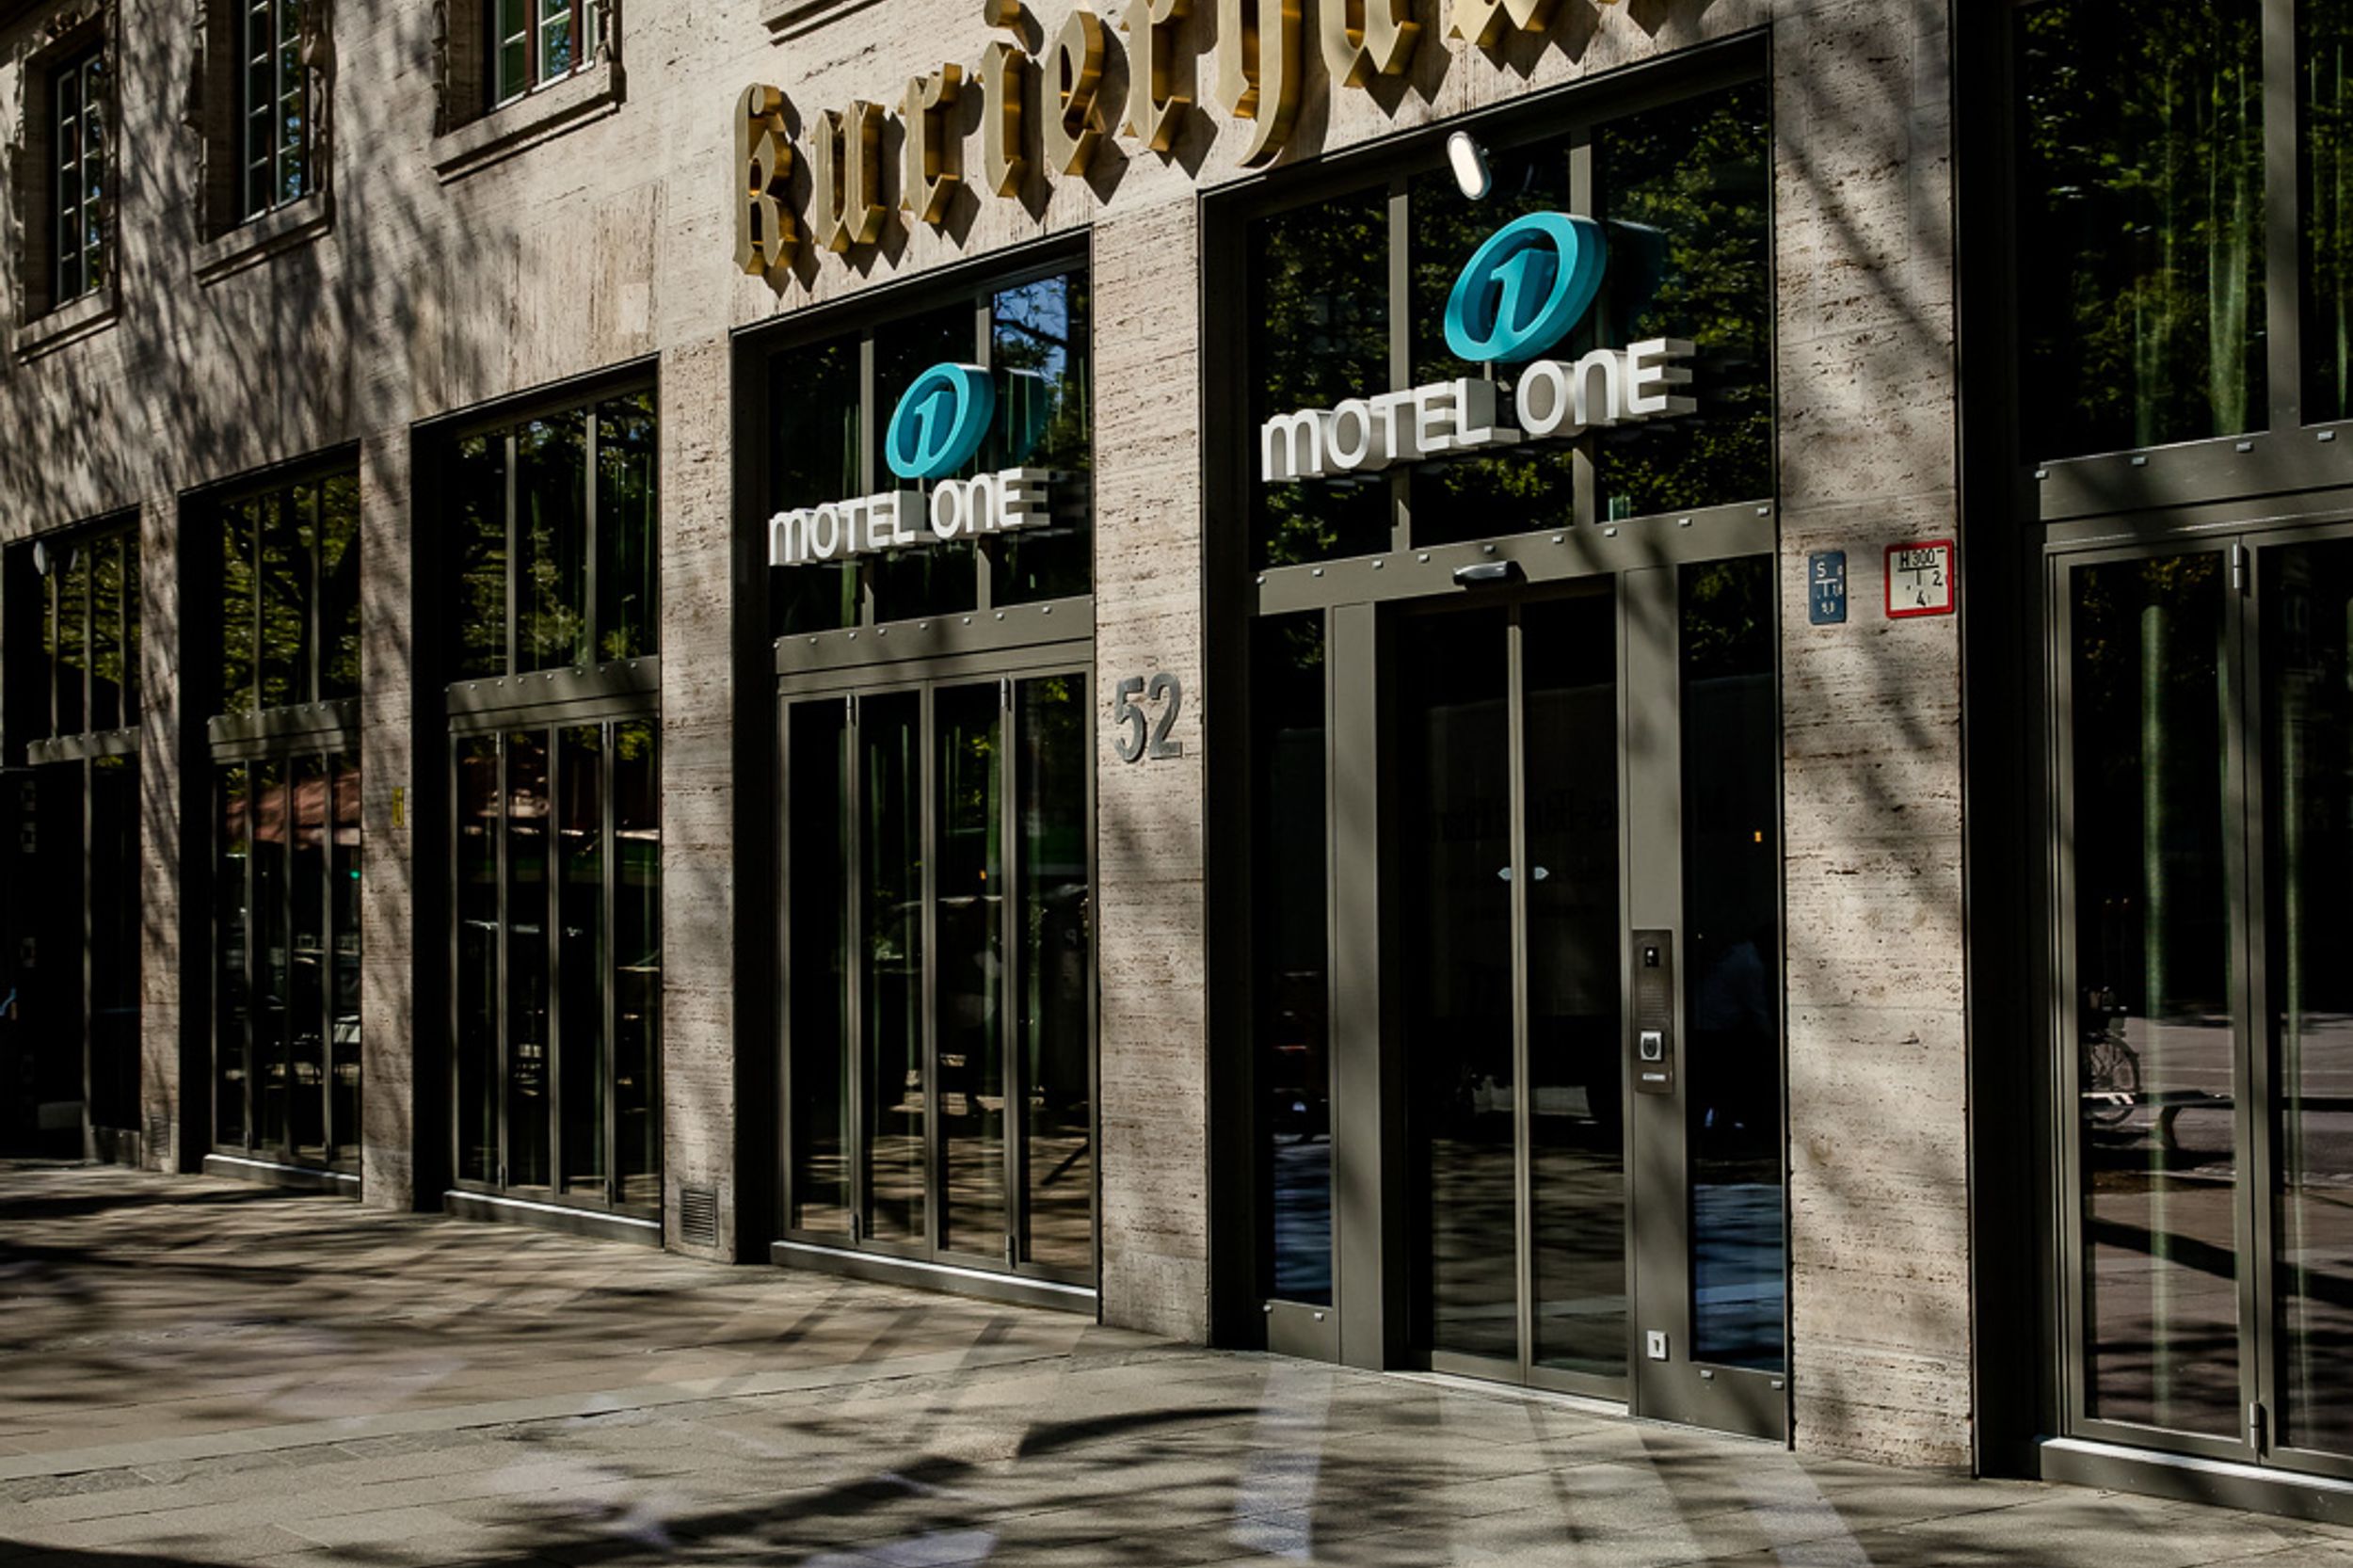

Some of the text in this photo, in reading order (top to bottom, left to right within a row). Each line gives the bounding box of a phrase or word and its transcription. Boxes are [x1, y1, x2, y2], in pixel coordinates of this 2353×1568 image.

[1516, 338, 1671, 437] ONE
[931, 466, 1026, 539] ONE
[1113, 673, 1183, 764] 52
